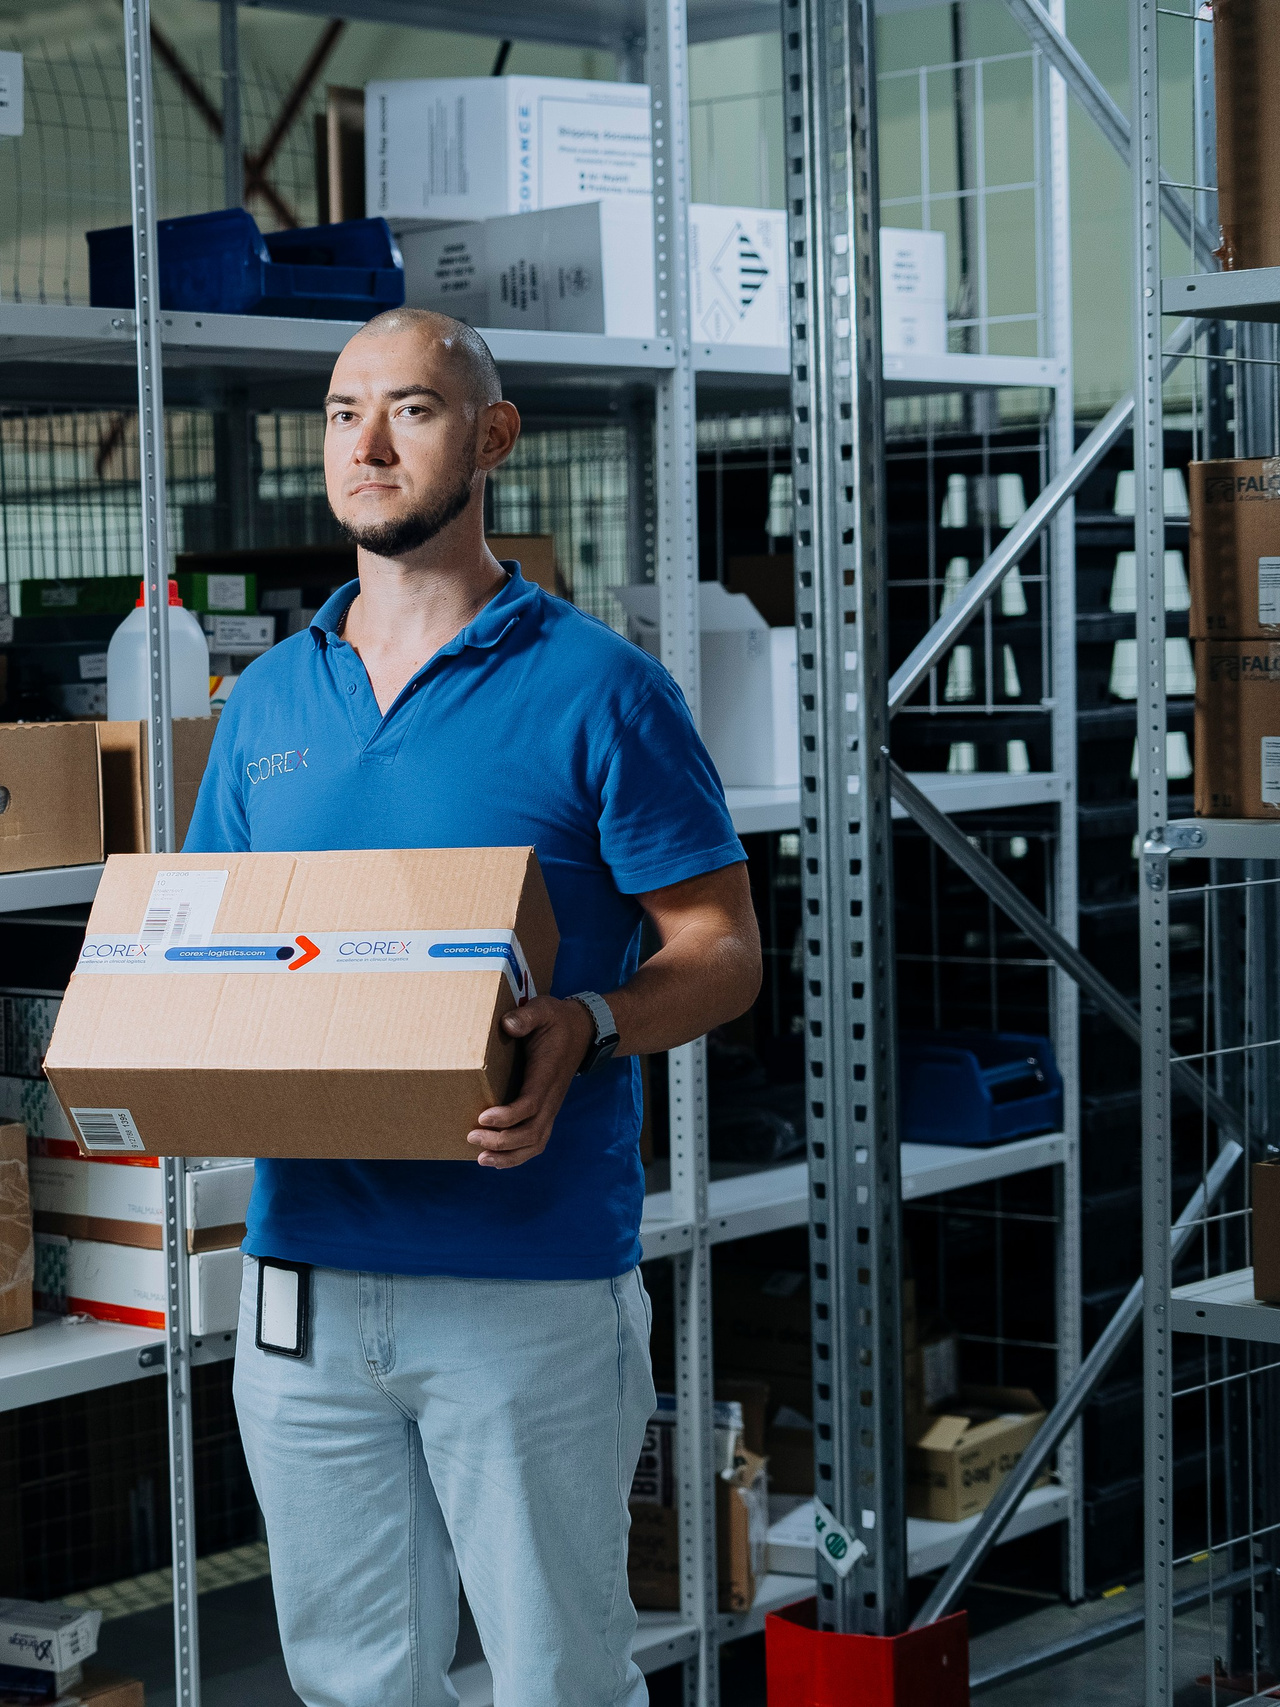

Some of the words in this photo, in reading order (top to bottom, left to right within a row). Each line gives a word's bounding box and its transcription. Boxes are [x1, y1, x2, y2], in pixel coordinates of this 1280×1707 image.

[246, 748, 309, 785] COREX
[82, 944, 150, 958] COREX
[179, 948, 266, 958] corex-logistics.com
[339, 940, 412, 956] COREX
[388, 956, 409, 964] logistics
[118, 1113, 130, 1128] 1395
